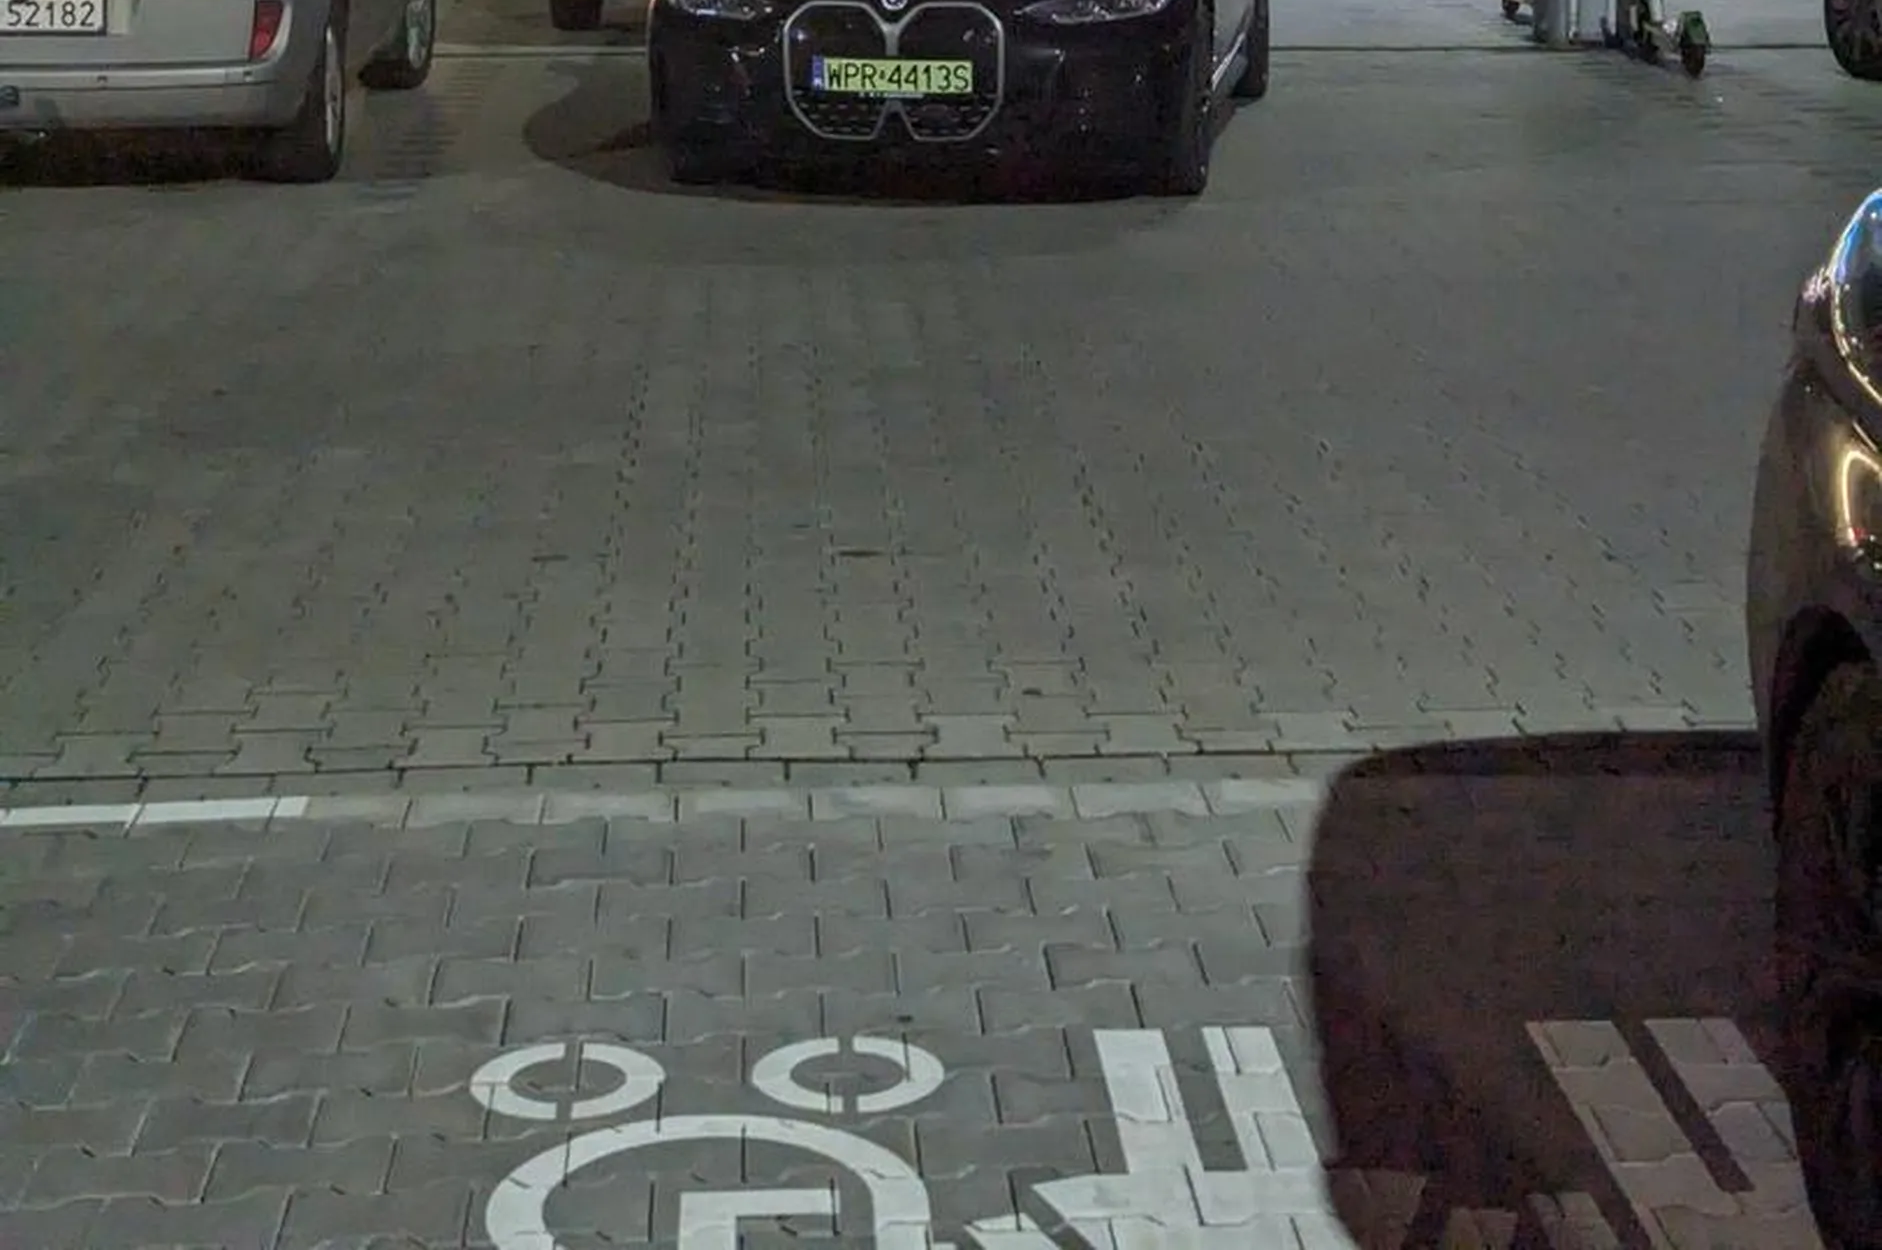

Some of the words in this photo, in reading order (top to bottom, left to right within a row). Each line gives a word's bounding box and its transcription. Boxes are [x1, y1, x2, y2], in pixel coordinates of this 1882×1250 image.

[7, 0, 95, 27] 52182
[828, 63, 876, 88] WPR
[887, 65, 969, 91] 4413S
